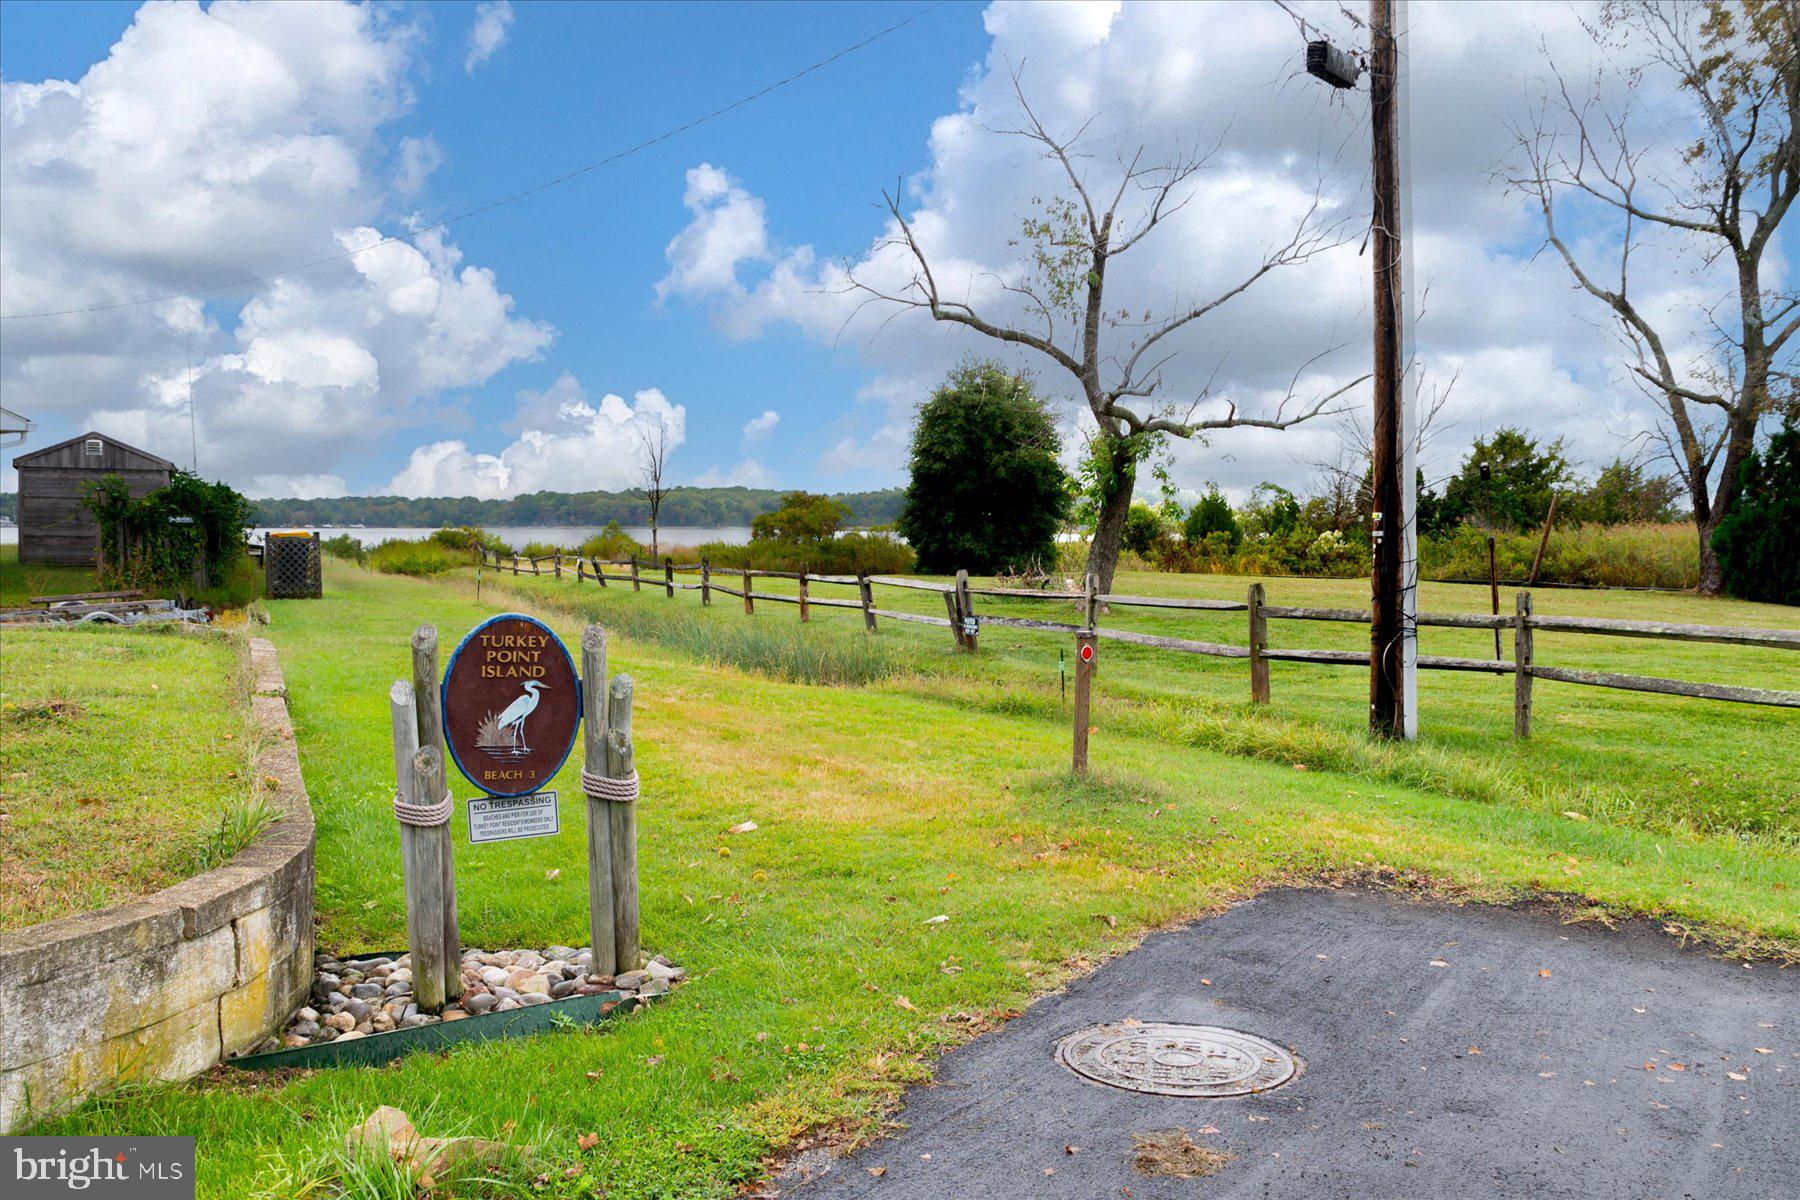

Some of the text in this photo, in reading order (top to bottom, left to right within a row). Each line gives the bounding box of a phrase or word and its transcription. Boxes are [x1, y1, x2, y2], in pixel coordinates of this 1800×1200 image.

[480, 635, 549, 648] TURKEY
[486, 651, 541, 663] POINT
[481, 665, 546, 678] ISLAND
[484, 770, 535, 780] BEACH 3
[473, 796, 552, 811] NO TRESPASSING
[483, 813, 502, 821] BEACHES
[473, 822, 489, 830] TURKEY
[490, 821, 501, 829] POINT
[479, 828, 507, 837] TRESPASSERS
[507, 826, 517, 834] WILL
[524, 823, 549, 831] PROSECUTED
